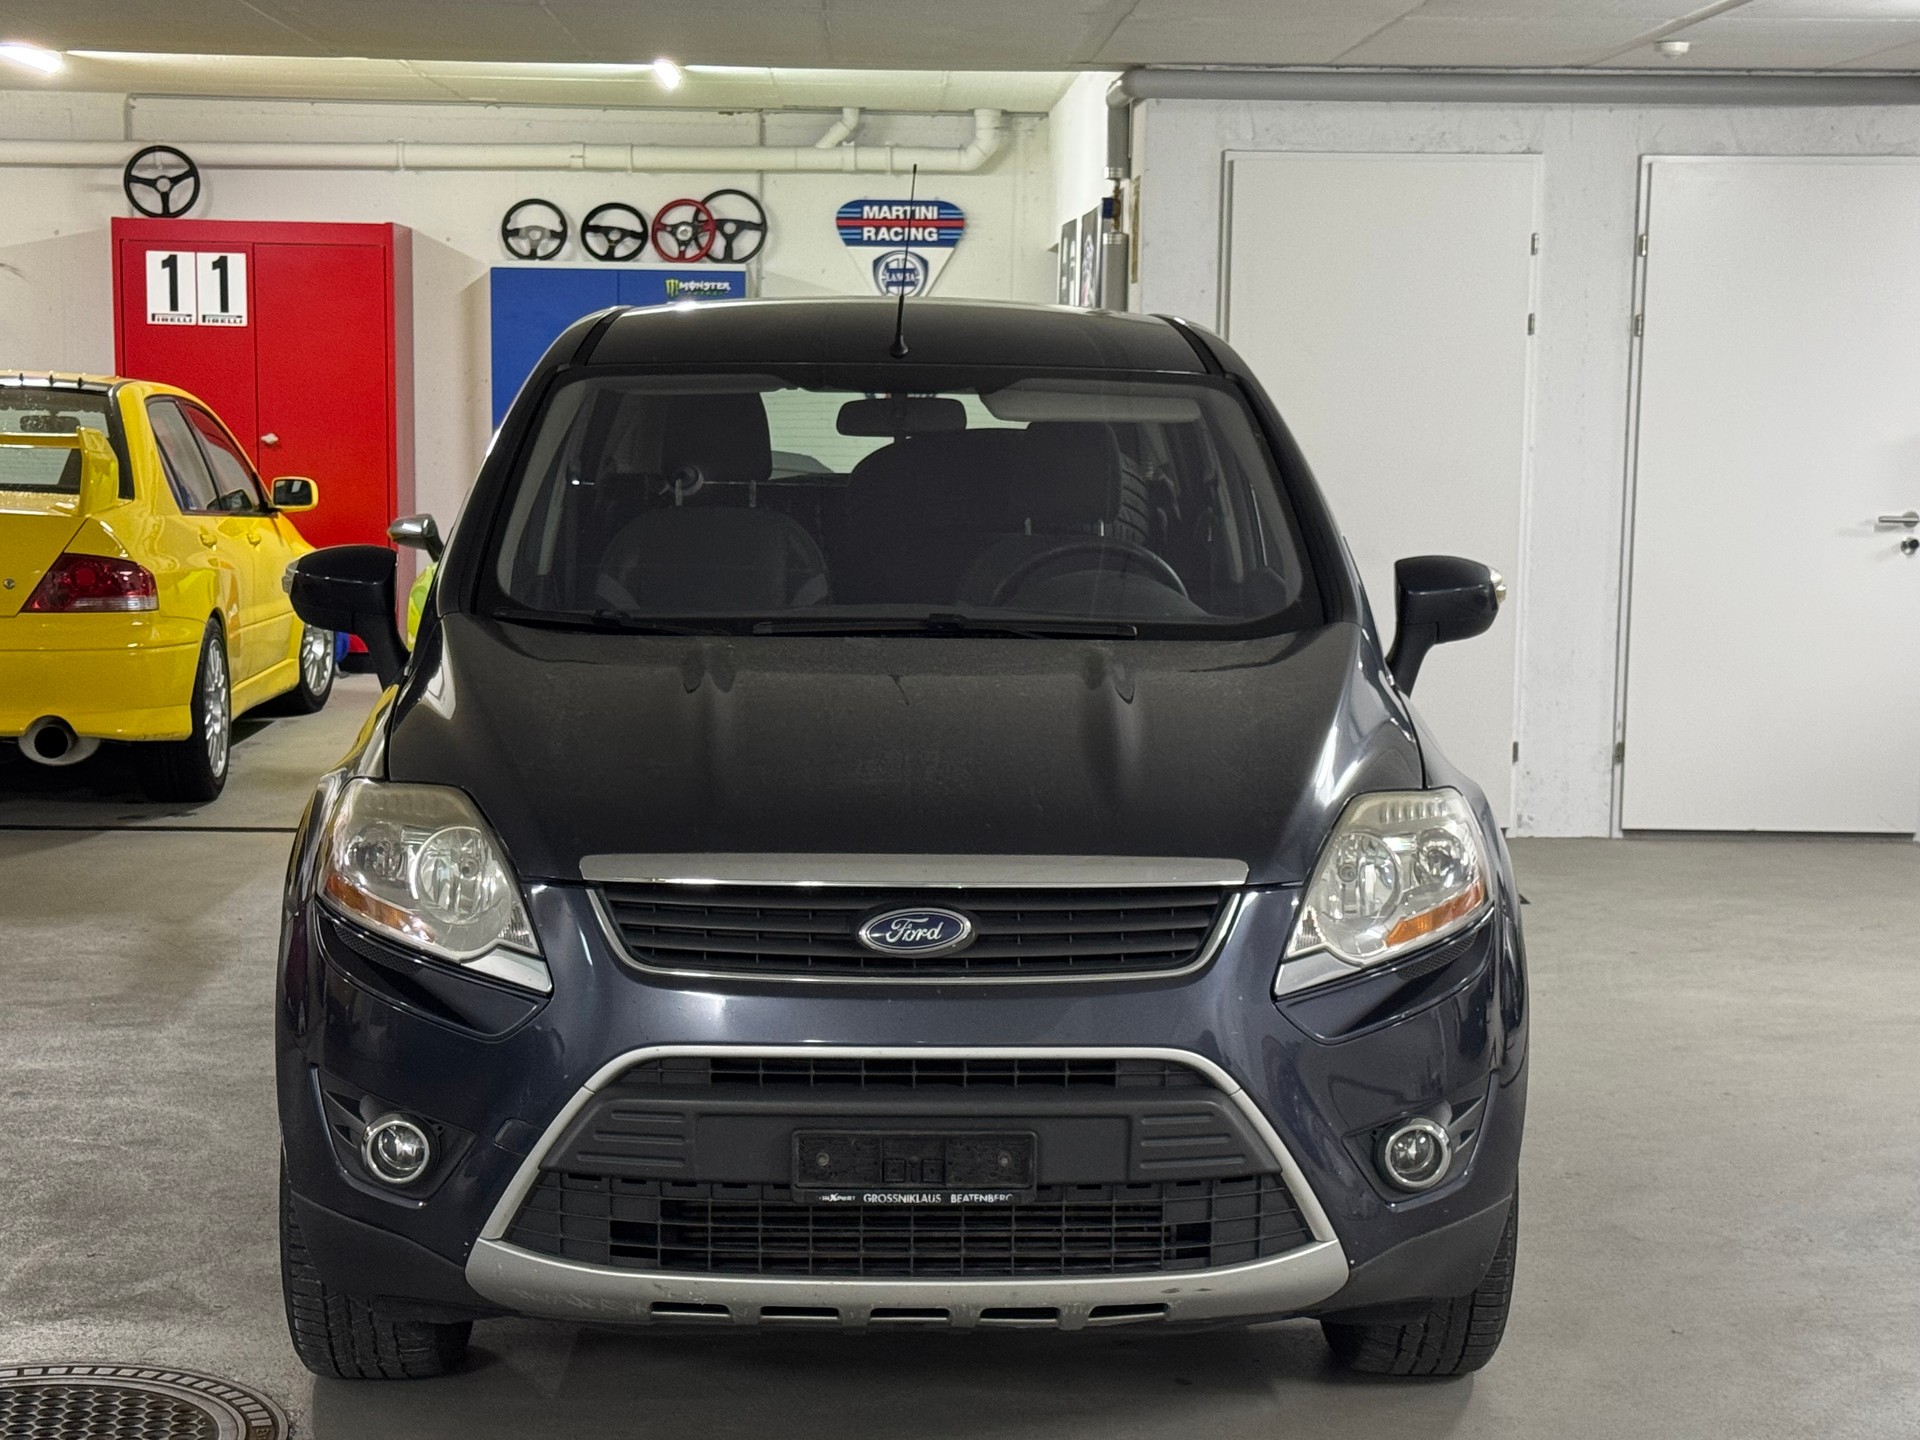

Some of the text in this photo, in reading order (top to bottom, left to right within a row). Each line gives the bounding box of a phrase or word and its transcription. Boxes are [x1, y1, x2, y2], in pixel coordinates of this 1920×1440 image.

[863, 205, 939, 220] MARTINI
[863, 226, 939, 242] RACING
[679, 280, 732, 292] MONSTER
[885, 917, 945, 943] Ford
[863, 1193, 942, 1204] GROSSNIKLAUS
